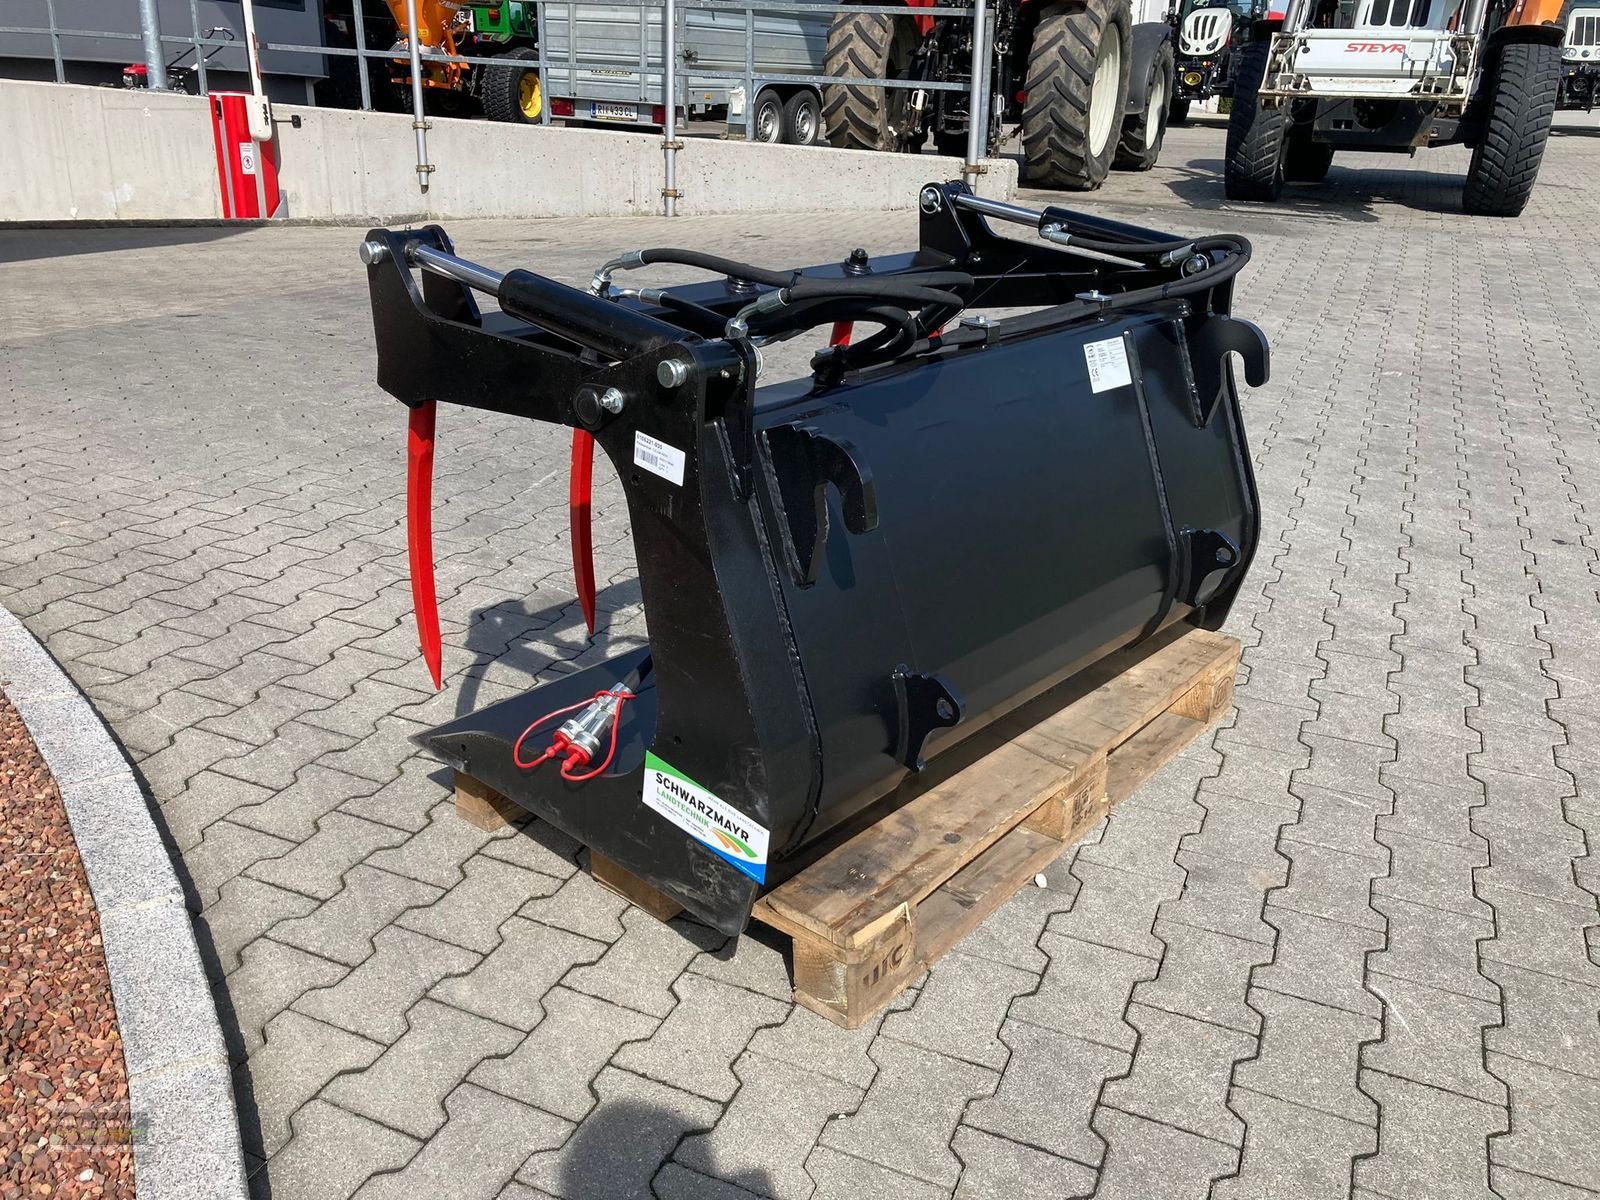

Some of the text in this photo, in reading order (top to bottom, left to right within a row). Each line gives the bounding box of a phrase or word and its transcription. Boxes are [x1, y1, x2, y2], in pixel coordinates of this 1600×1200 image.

[1344, 43, 1406, 54] STEYR
[655, 772, 750, 843] SCHWARZMAYR
[656, 787, 711, 829] LANDTECHNIK
